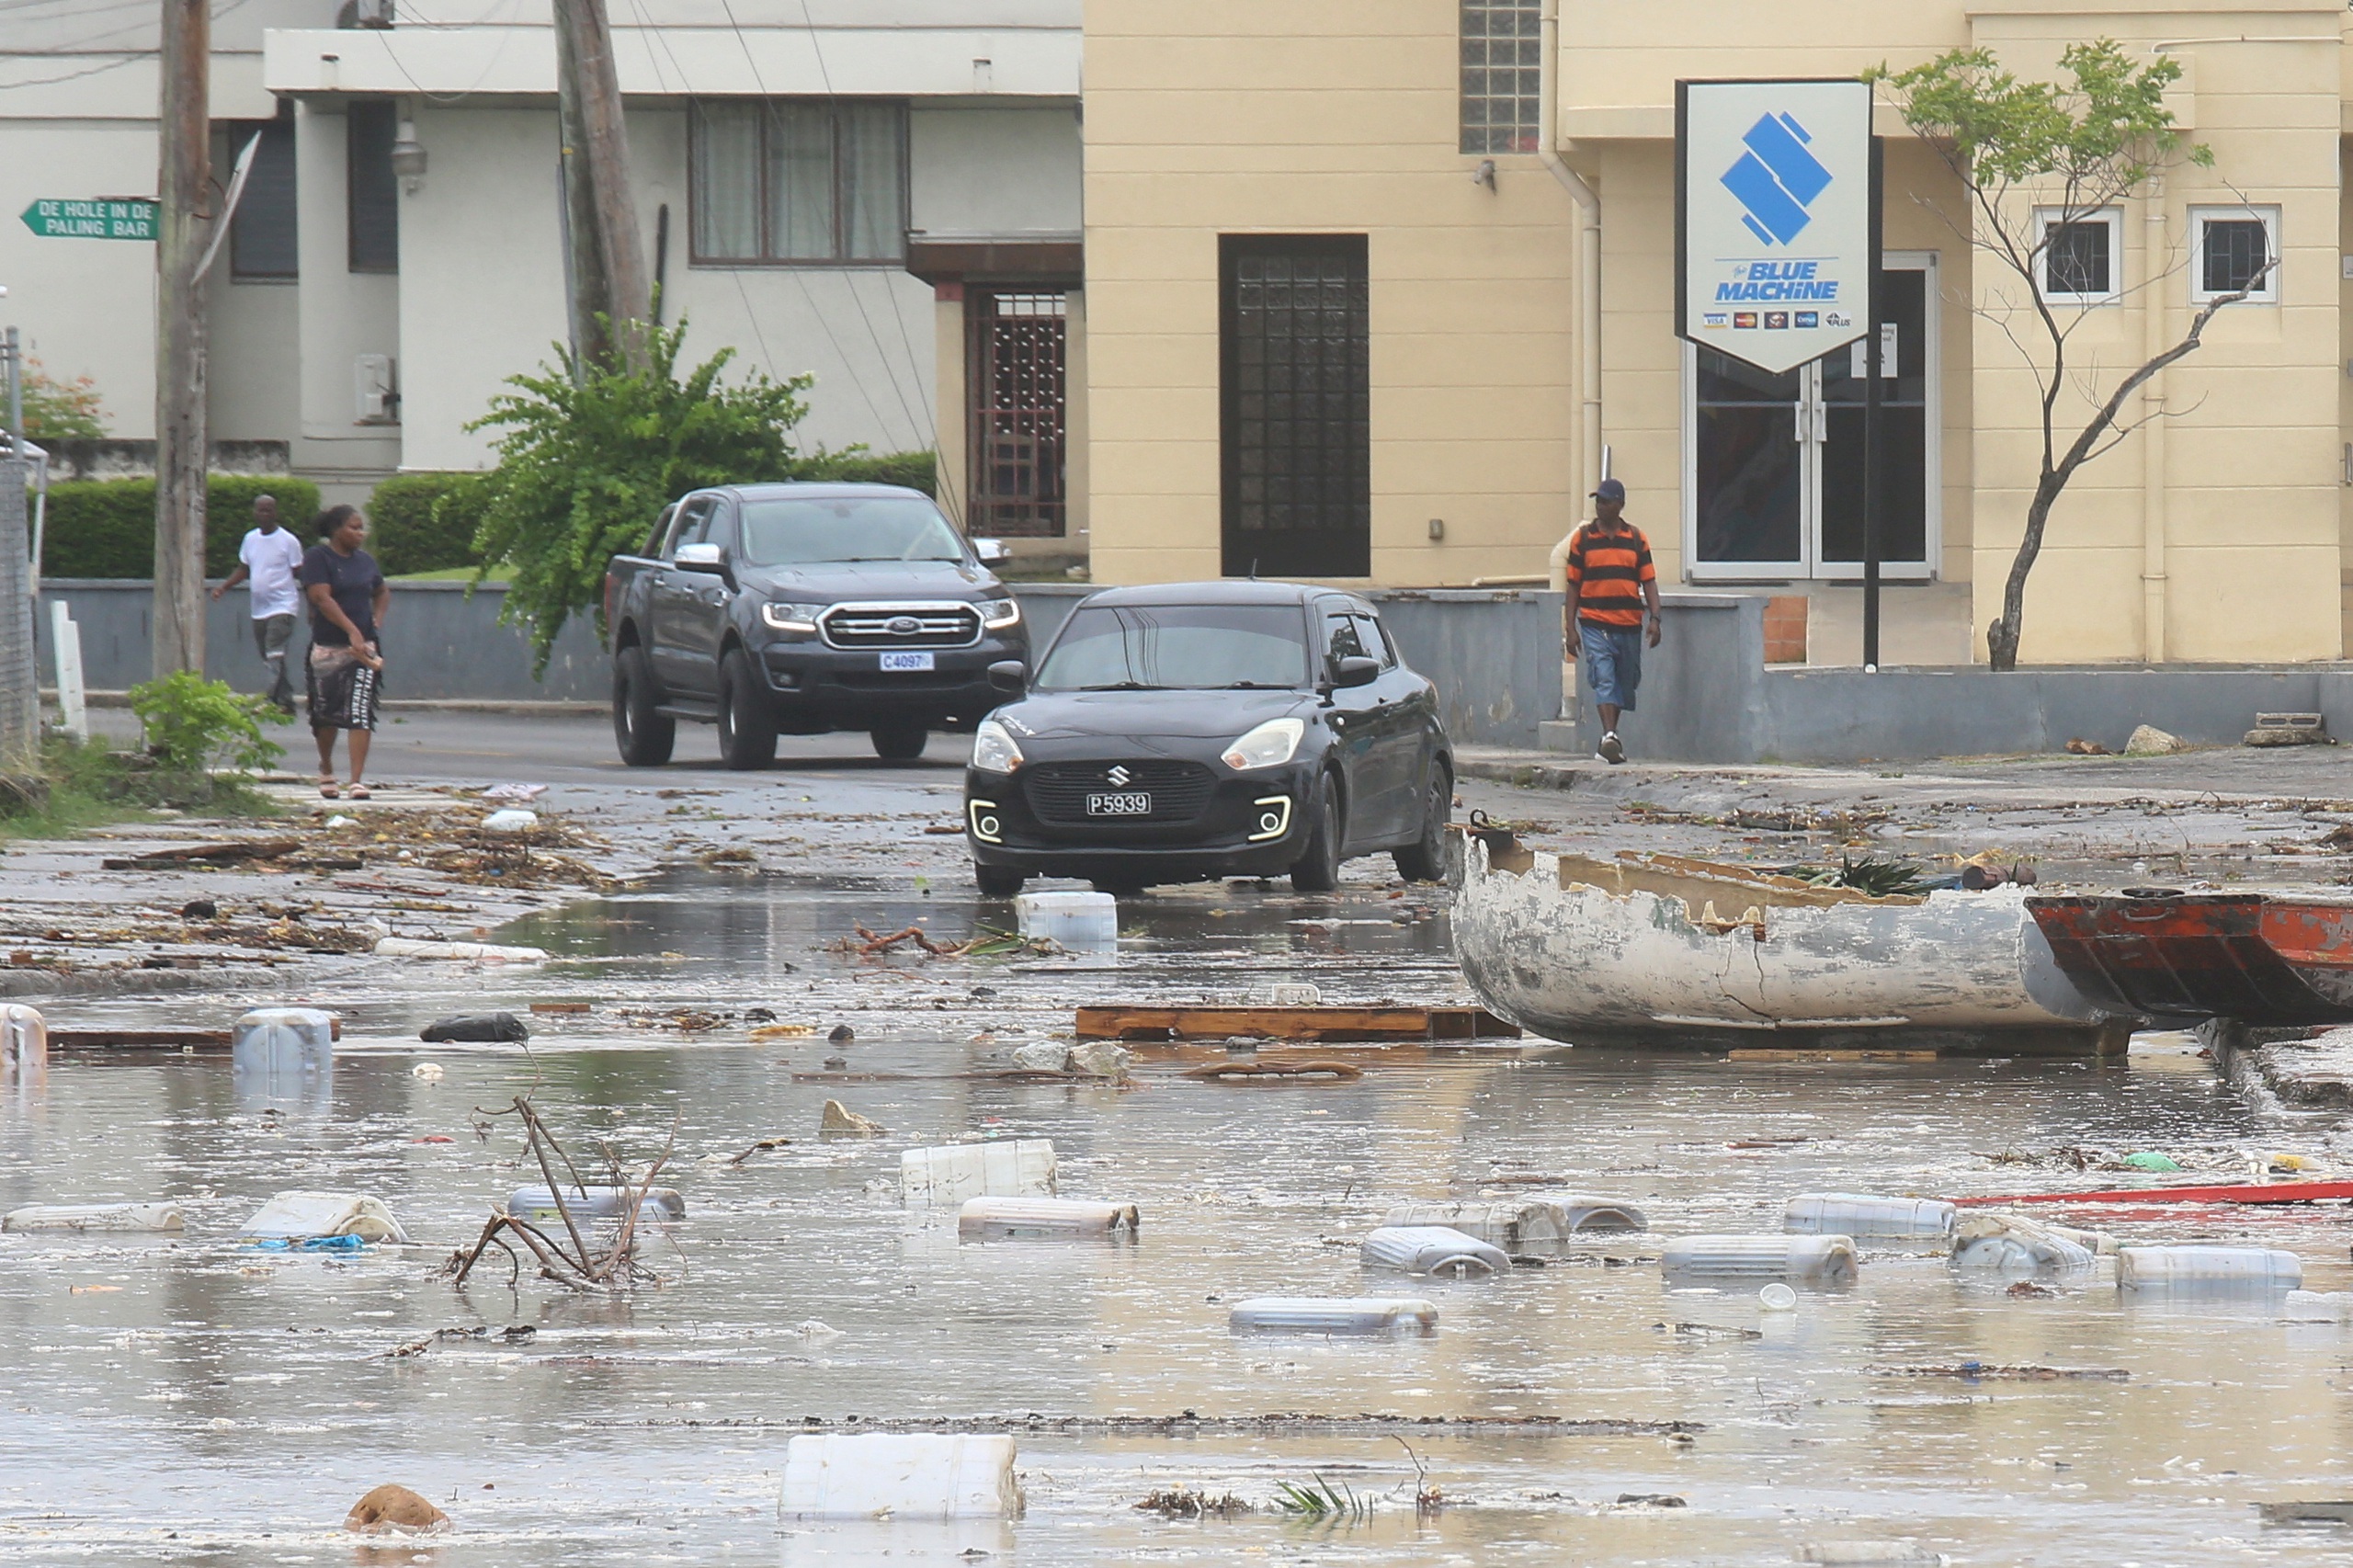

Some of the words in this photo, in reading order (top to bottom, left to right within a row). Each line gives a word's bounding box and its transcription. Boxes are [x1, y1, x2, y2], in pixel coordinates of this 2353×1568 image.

[39, 200, 60, 217] DE
[64, 202, 106, 218] HOLE
[110, 204, 127, 219] IN
[131, 204, 153, 220] DE
[46, 219, 106, 235] PALING
[112, 221, 150, 236] BAR
[1747, 261, 1818, 280] BLUE
[1832, 318, 1851, 326] PLUS
[1091, 795, 1147, 812] P5939
